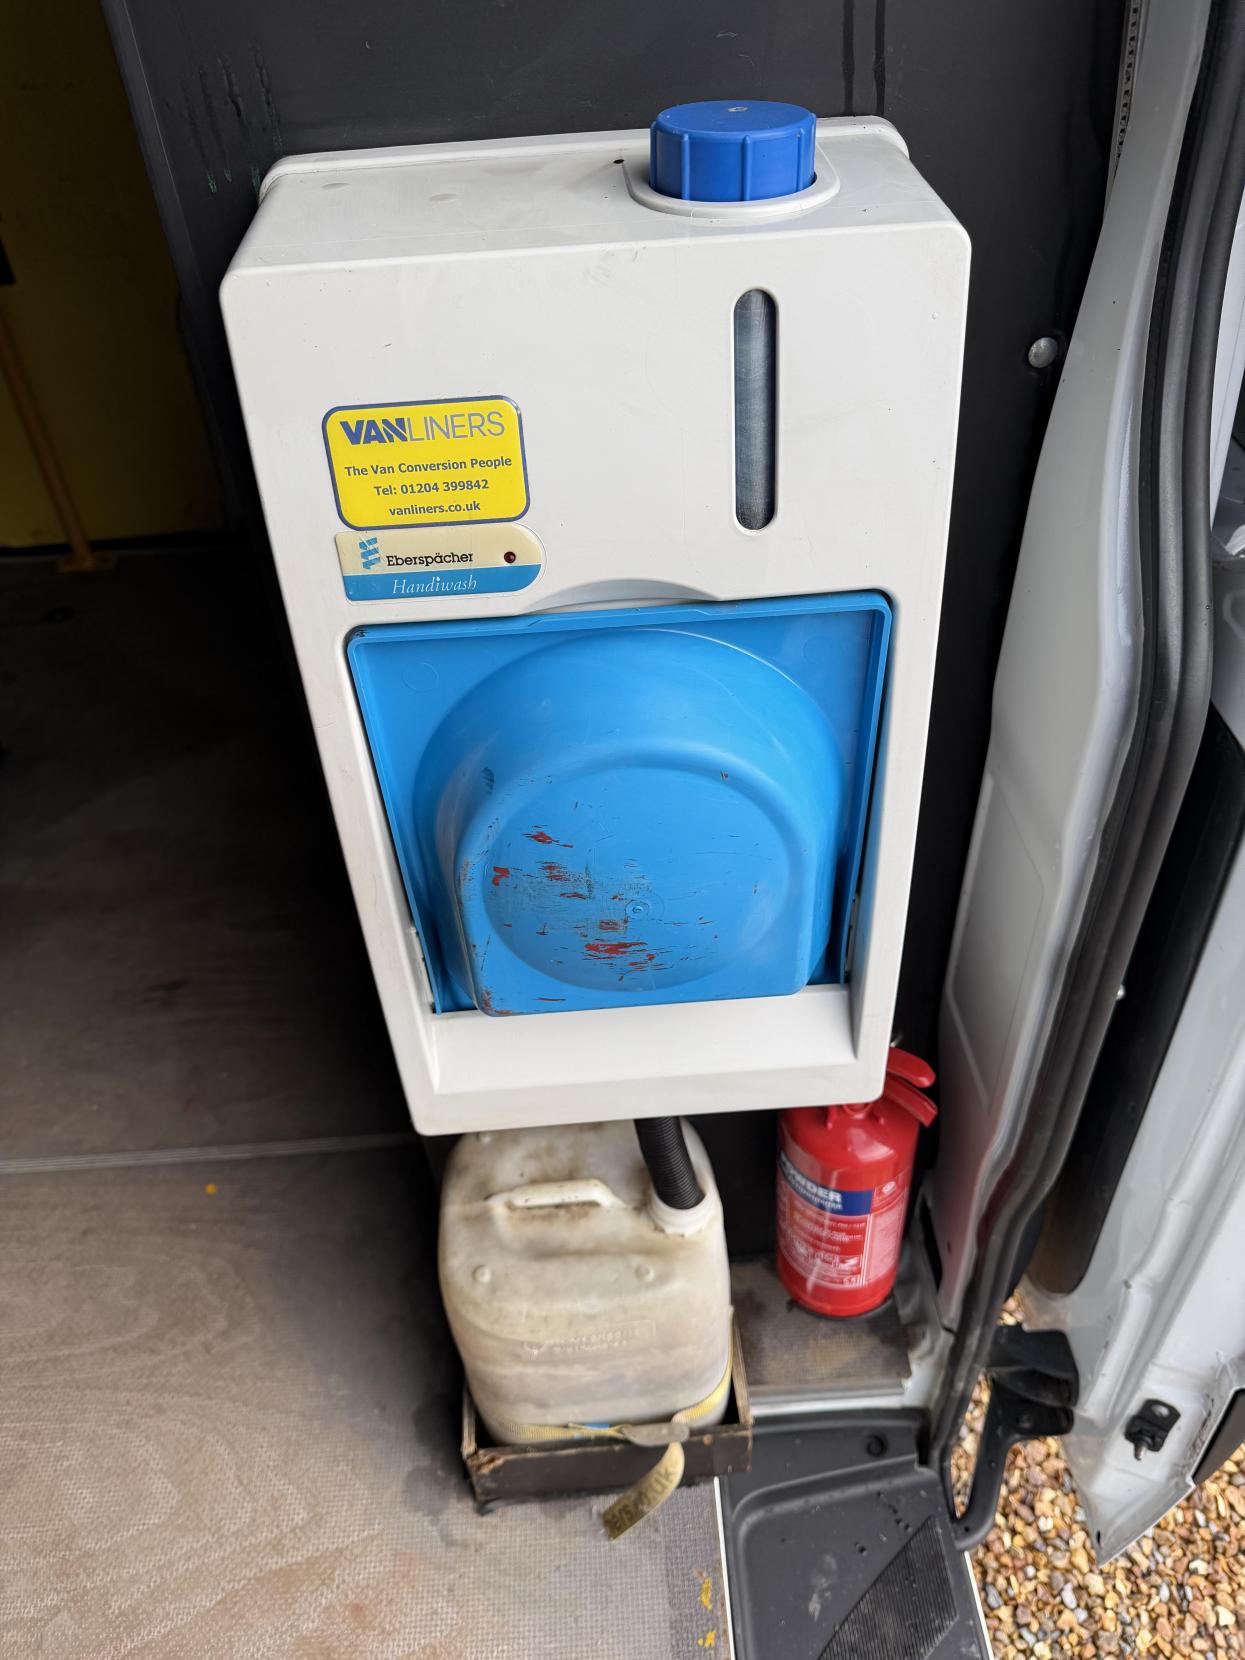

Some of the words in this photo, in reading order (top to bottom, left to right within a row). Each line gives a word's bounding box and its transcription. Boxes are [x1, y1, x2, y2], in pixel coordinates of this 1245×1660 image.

[339, 411, 505, 446] VANLINERS
[344, 466, 369, 477] The
[371, 464, 395, 475] Van
[398, 460, 467, 474] Conversion
[470, 456, 512, 469] People
[374, 485, 397, 496] Tel:
[400, 482, 440, 495] 01204
[443, 479, 489, 492] 399842
[388, 501, 481, 516] vanliners.co.uk
[386, 552, 474, 567] Eberspächer
[392, 575, 478, 594] Handiwash
